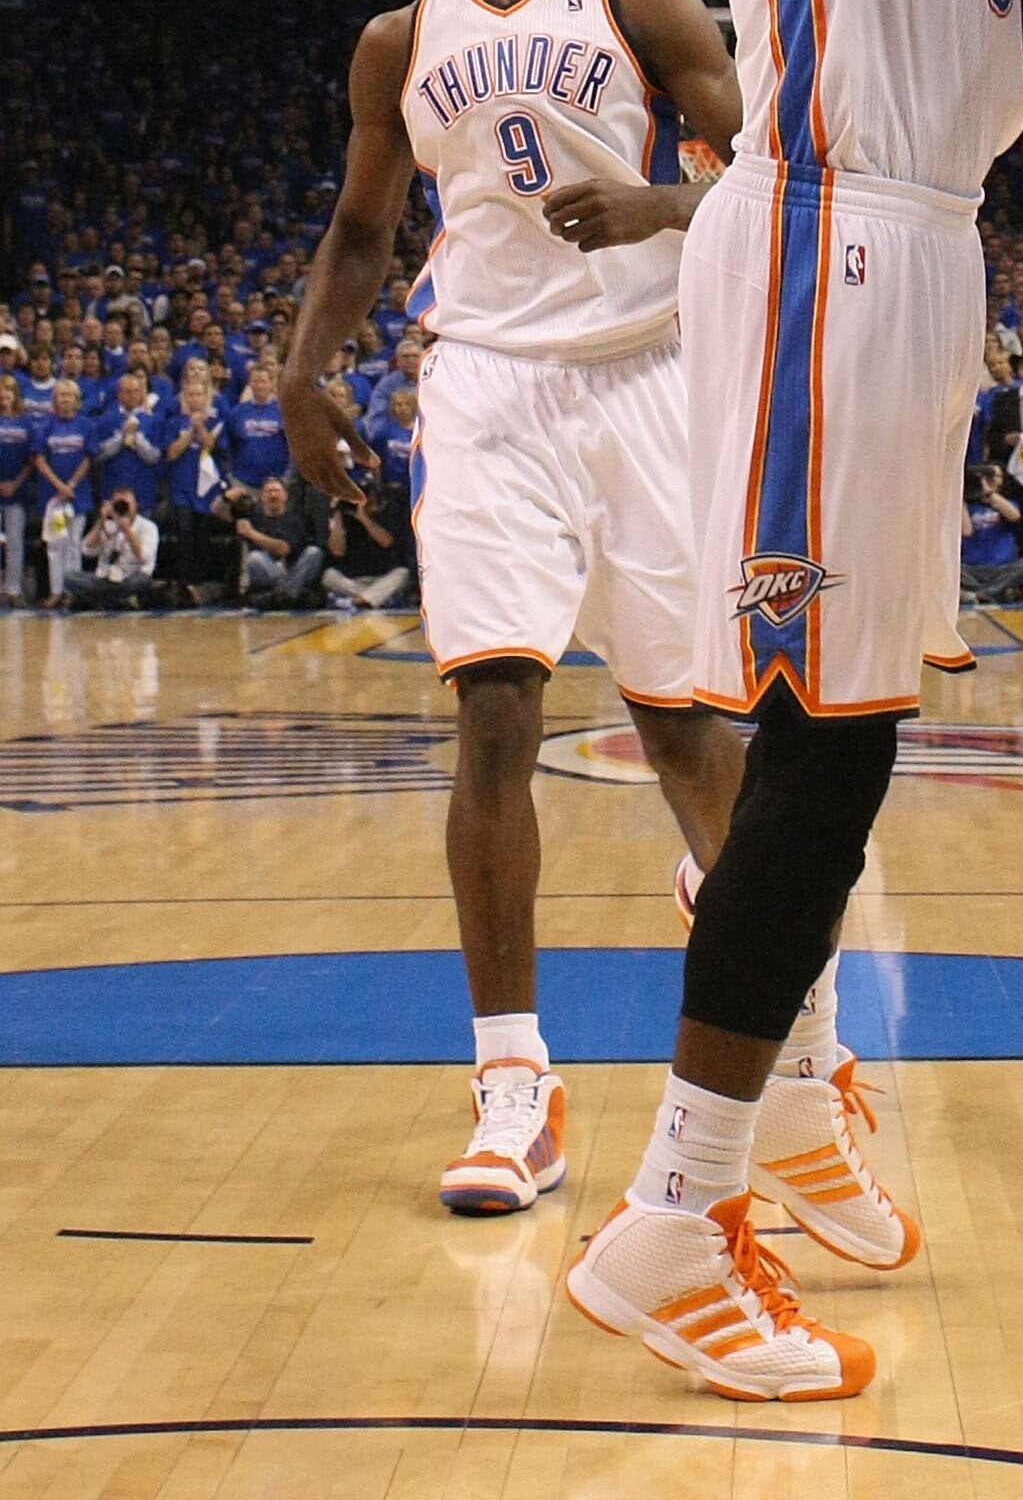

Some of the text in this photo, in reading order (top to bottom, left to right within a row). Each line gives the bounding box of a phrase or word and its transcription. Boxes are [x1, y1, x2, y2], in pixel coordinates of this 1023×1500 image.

[418, 33, 617, 131] THUNDER
[495, 110, 553, 197] 9
[738, 568, 807, 611] OKC
